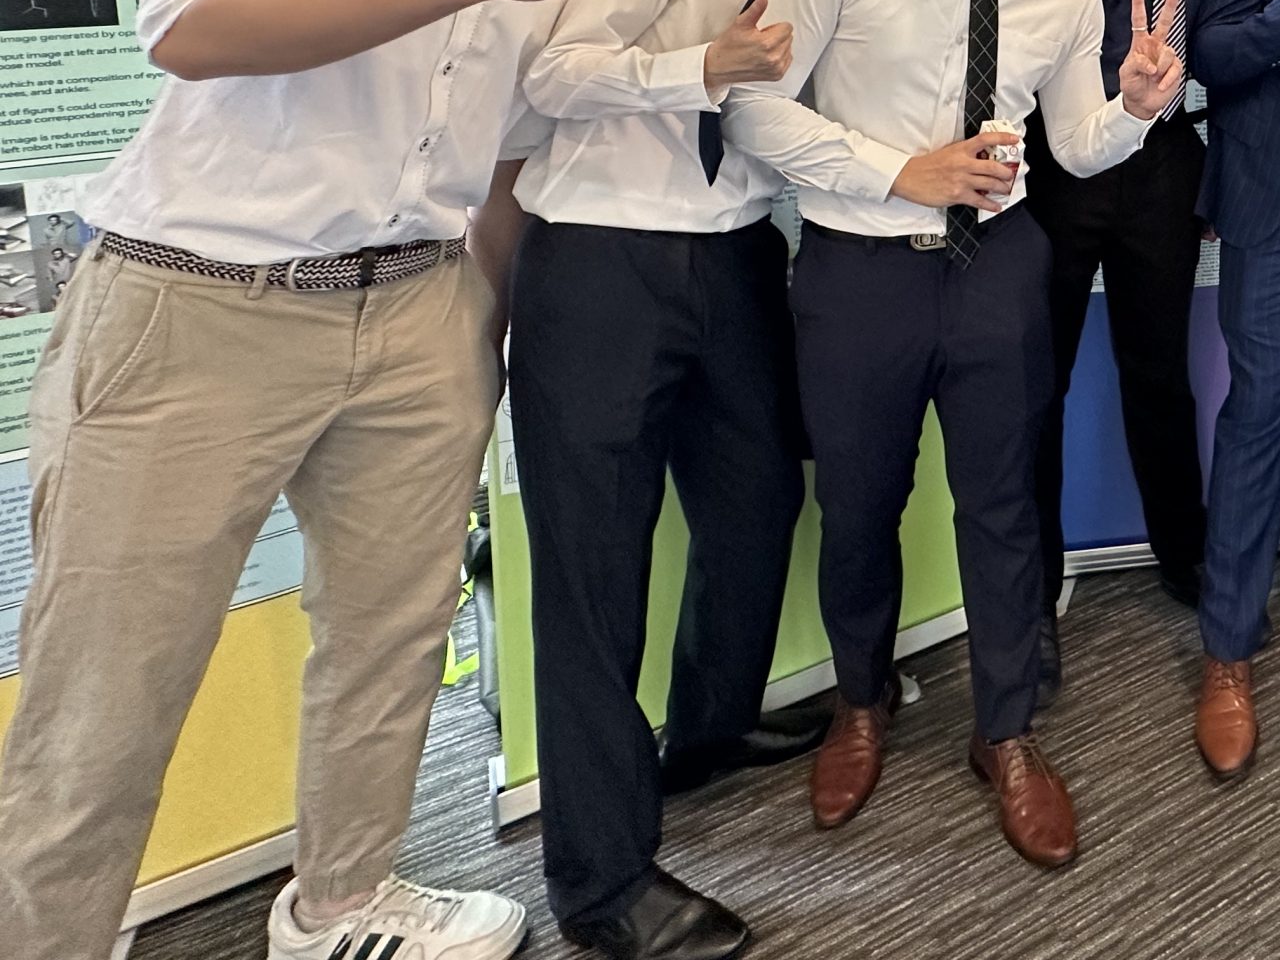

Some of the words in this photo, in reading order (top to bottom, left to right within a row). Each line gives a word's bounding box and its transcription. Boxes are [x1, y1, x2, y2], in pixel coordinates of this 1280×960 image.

[23, 106, 55, 116] figure
[66, 102, 97, 111] could
[99, 99, 143, 109] correctly
[23, 144, 53, 152] robot
[76, 138, 105, 147] three
